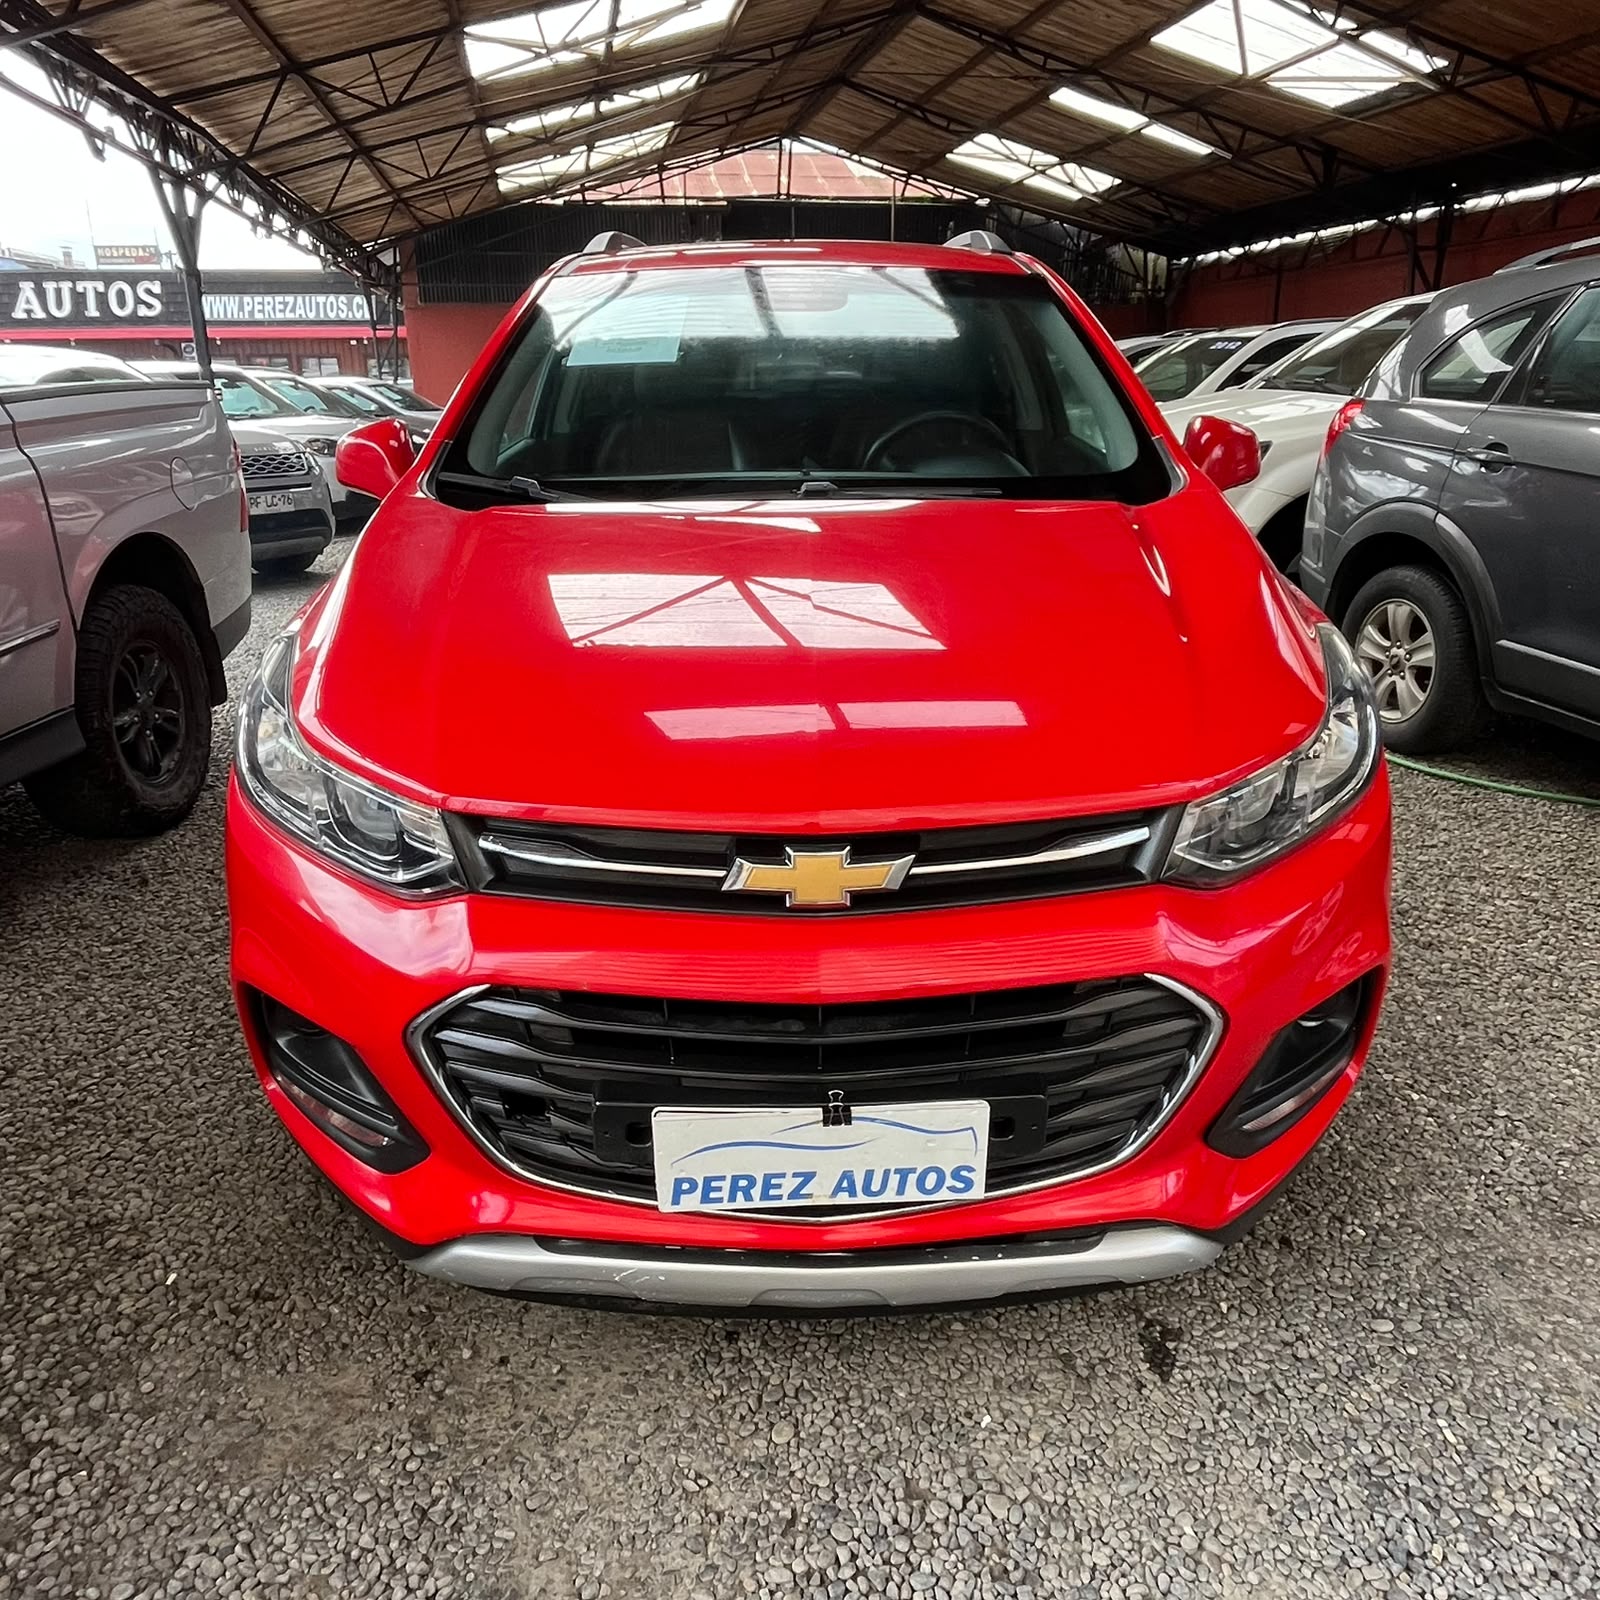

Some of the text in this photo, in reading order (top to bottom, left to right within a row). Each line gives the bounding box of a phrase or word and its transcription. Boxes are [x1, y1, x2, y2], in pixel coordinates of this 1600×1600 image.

[11, 280, 162, 319] AUTOS
[670, 1165, 977, 1206] PEREZ AUTOS
